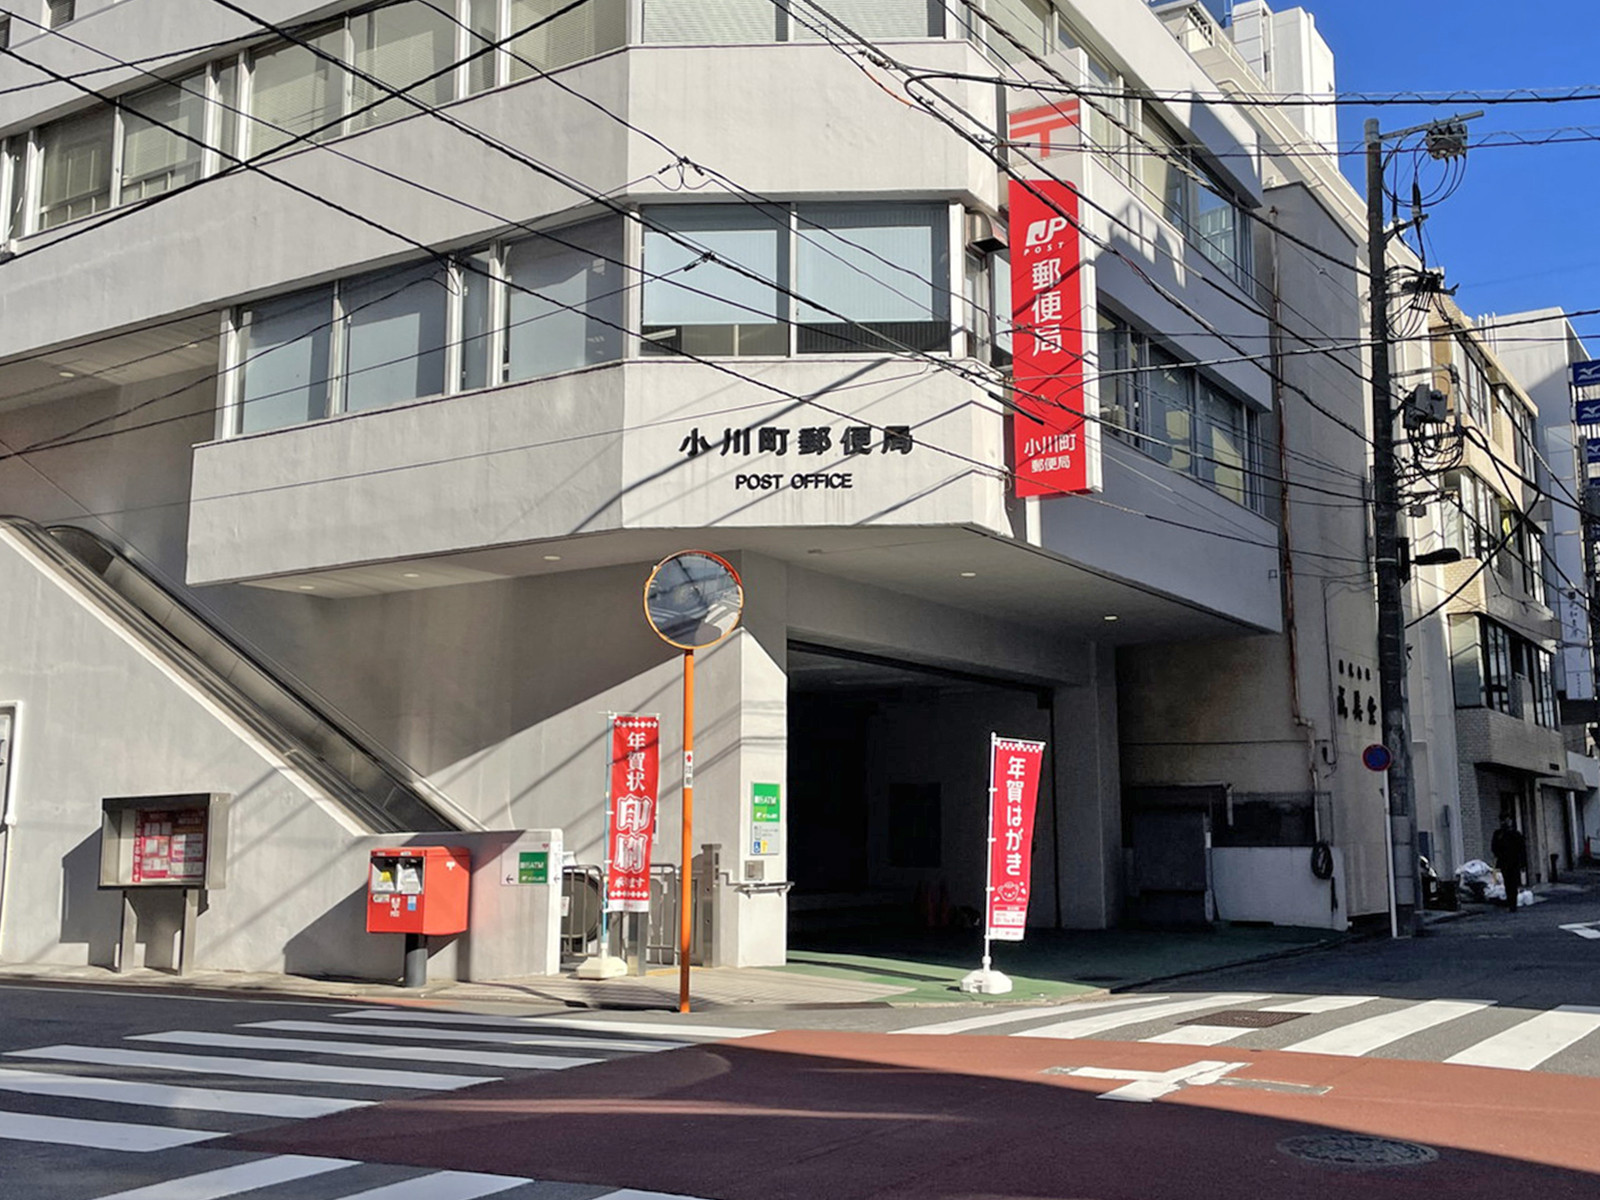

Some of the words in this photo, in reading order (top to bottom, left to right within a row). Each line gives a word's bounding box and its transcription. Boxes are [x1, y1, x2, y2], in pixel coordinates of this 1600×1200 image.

[1023, 241, 1064, 256] POST
[1031, 258, 1062, 357] 郵便局
[679, 425, 913, 457] 小川町郵便局
[1024, 434, 1076, 457] 小川町
[1031, 455, 1071, 473] 郵便局
[735, 474, 783, 489] POST
[791, 473, 853, 489] OFFICE
[626, 731, 646, 791] 年賀状
[1005, 755, 1026, 876] 年賀はがき
